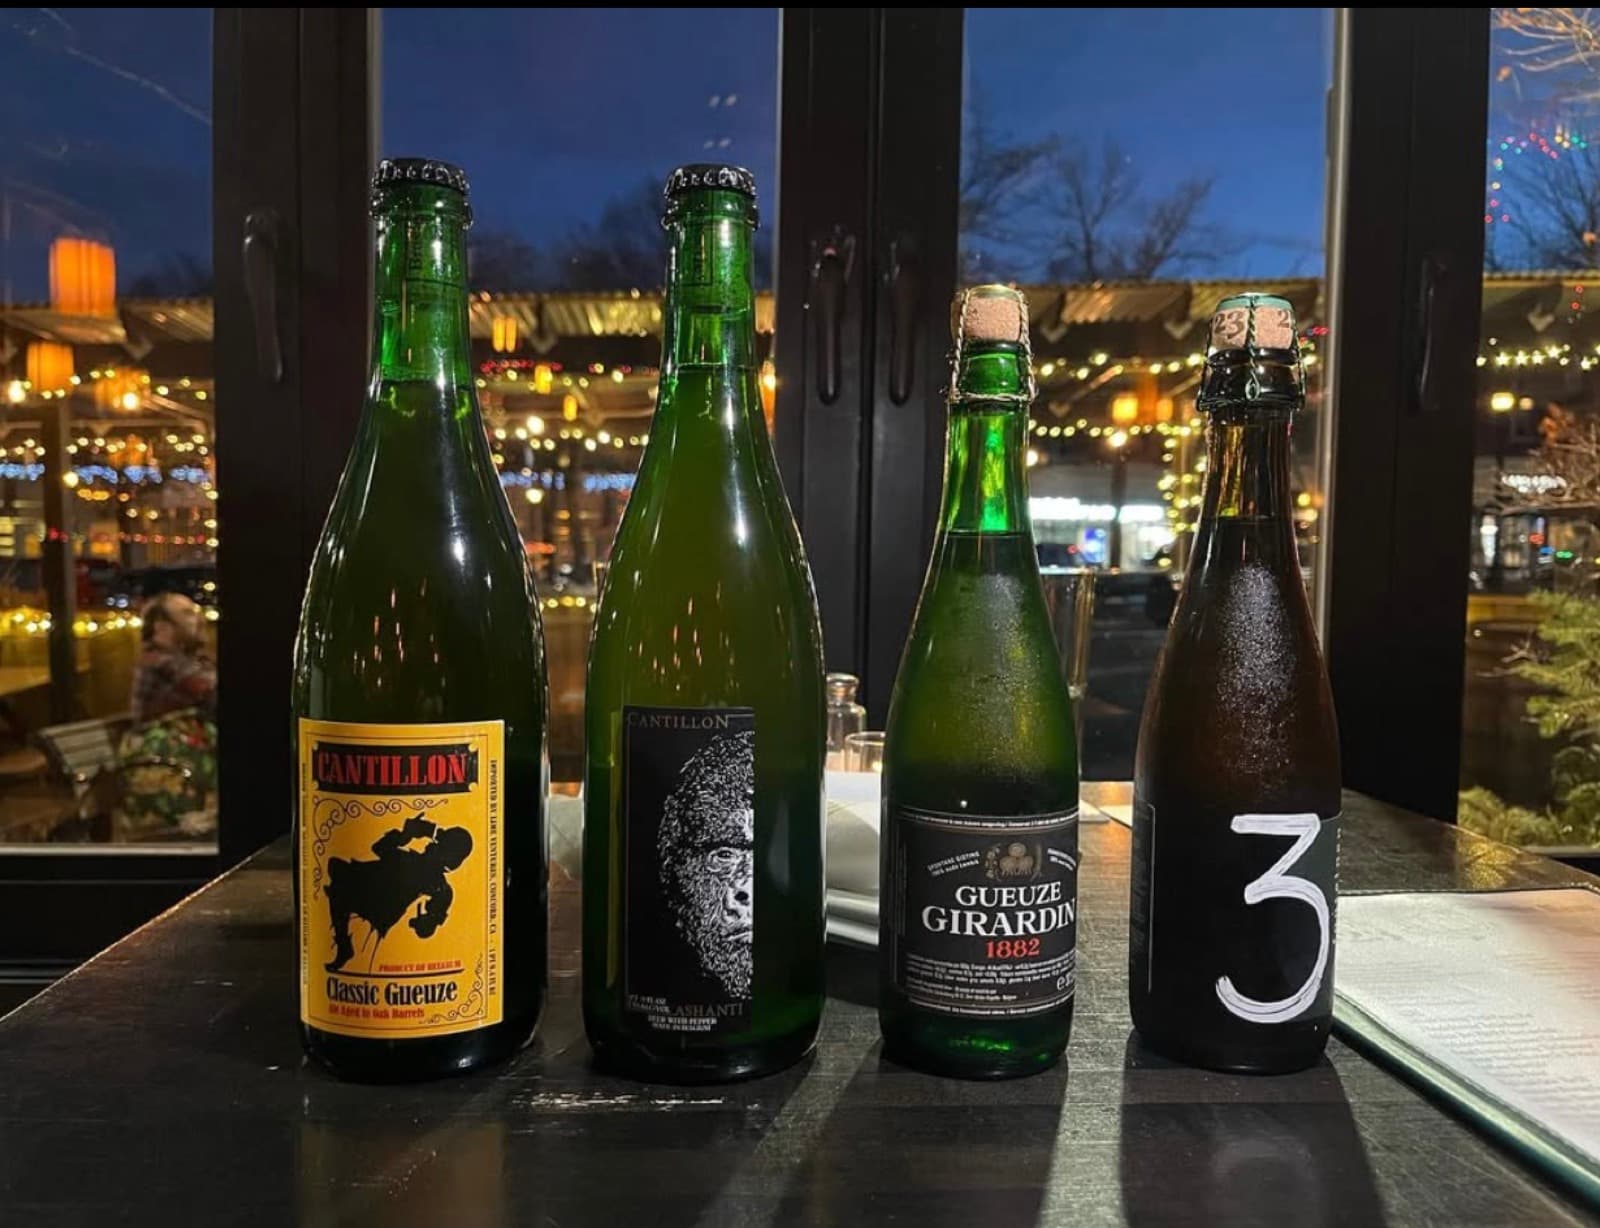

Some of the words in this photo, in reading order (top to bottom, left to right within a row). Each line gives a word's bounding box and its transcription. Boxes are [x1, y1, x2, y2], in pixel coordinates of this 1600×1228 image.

[1214, 310, 1245, 340] 23
[627, 711, 729, 729] CANTILLON
[318, 751, 468, 787] CANTILLON
[490, 760, 498, 800] IMPORTED
[490, 803, 498, 813] BY
[955, 881, 1062, 907] GUEUZE
[921, 897, 1076, 937] GIRARDIN
[1215, 812, 1330, 1024] 3
[985, 938, 1041, 959] 1882
[327, 976, 380, 1006] Classic
[384, 980, 458, 1006] Gueuze
[673, 1003, 744, 1017] ASHANTI
